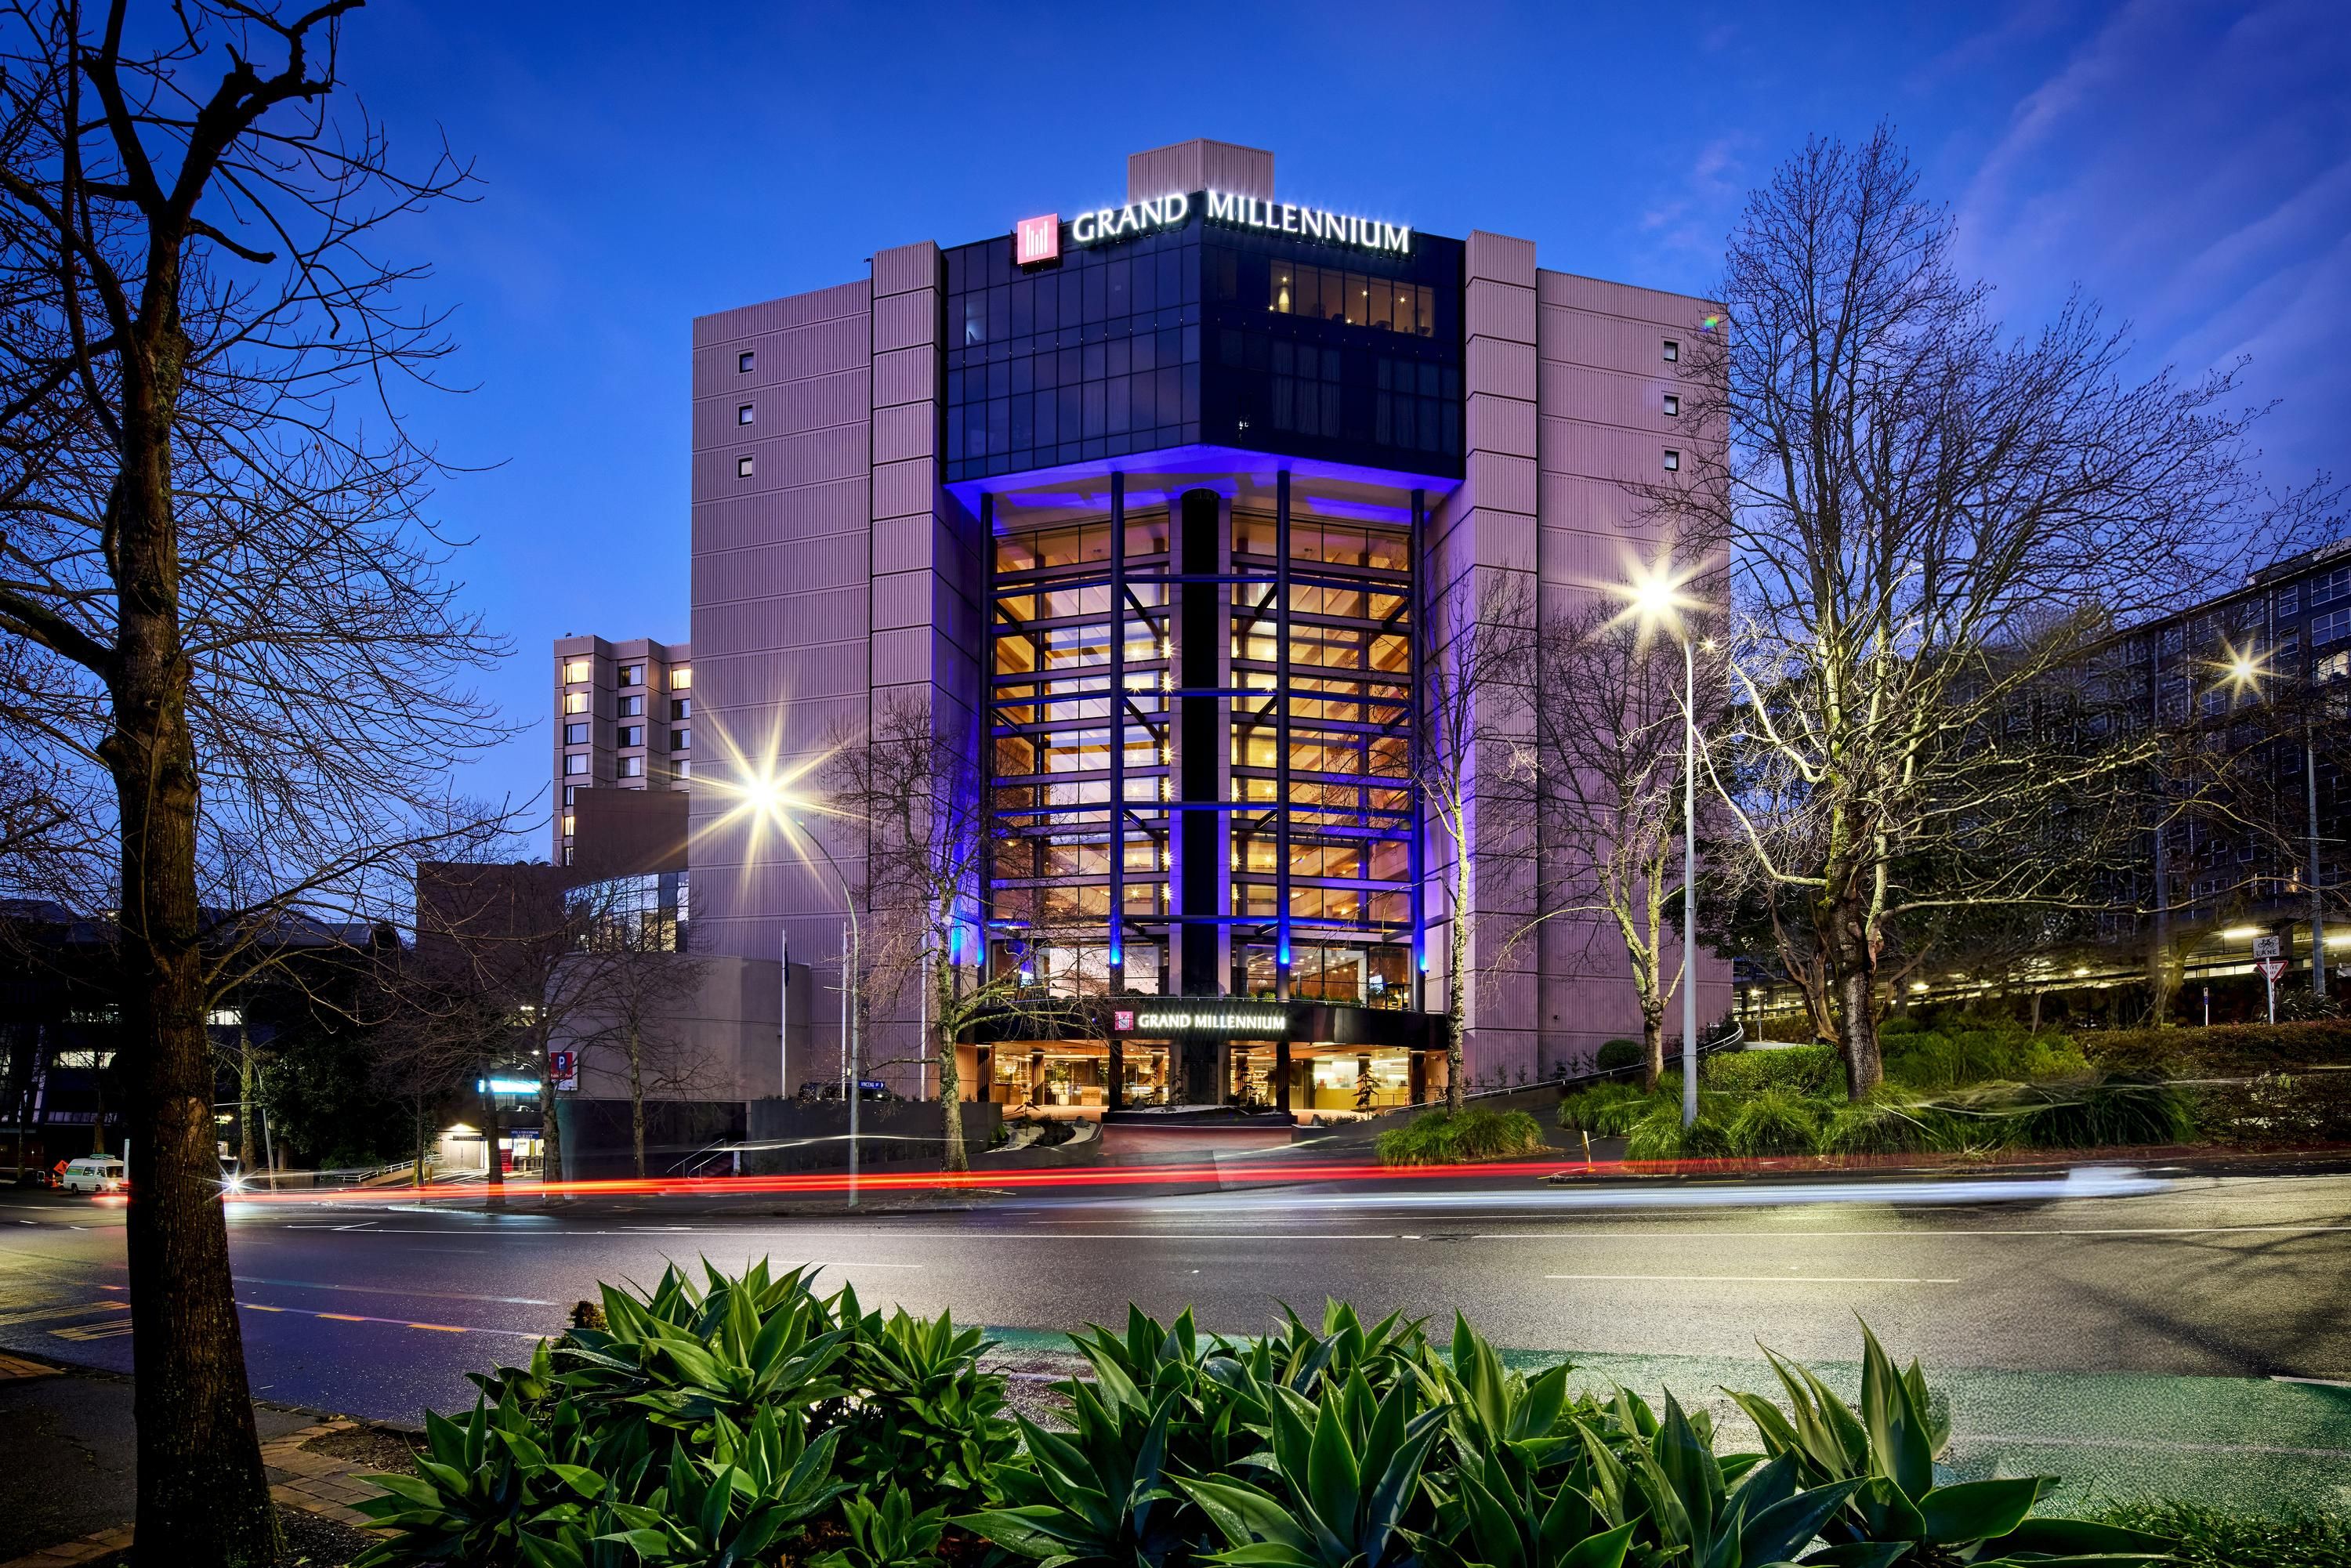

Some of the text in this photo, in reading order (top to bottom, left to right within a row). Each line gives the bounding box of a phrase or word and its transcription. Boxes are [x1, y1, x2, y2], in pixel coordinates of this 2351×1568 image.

[1073, 190, 1410, 253] GRAND MILLENNIUM
[1138, 1014, 1285, 1030] GRAND MILLENNIUM
[559, 1056, 565, 1069] P
